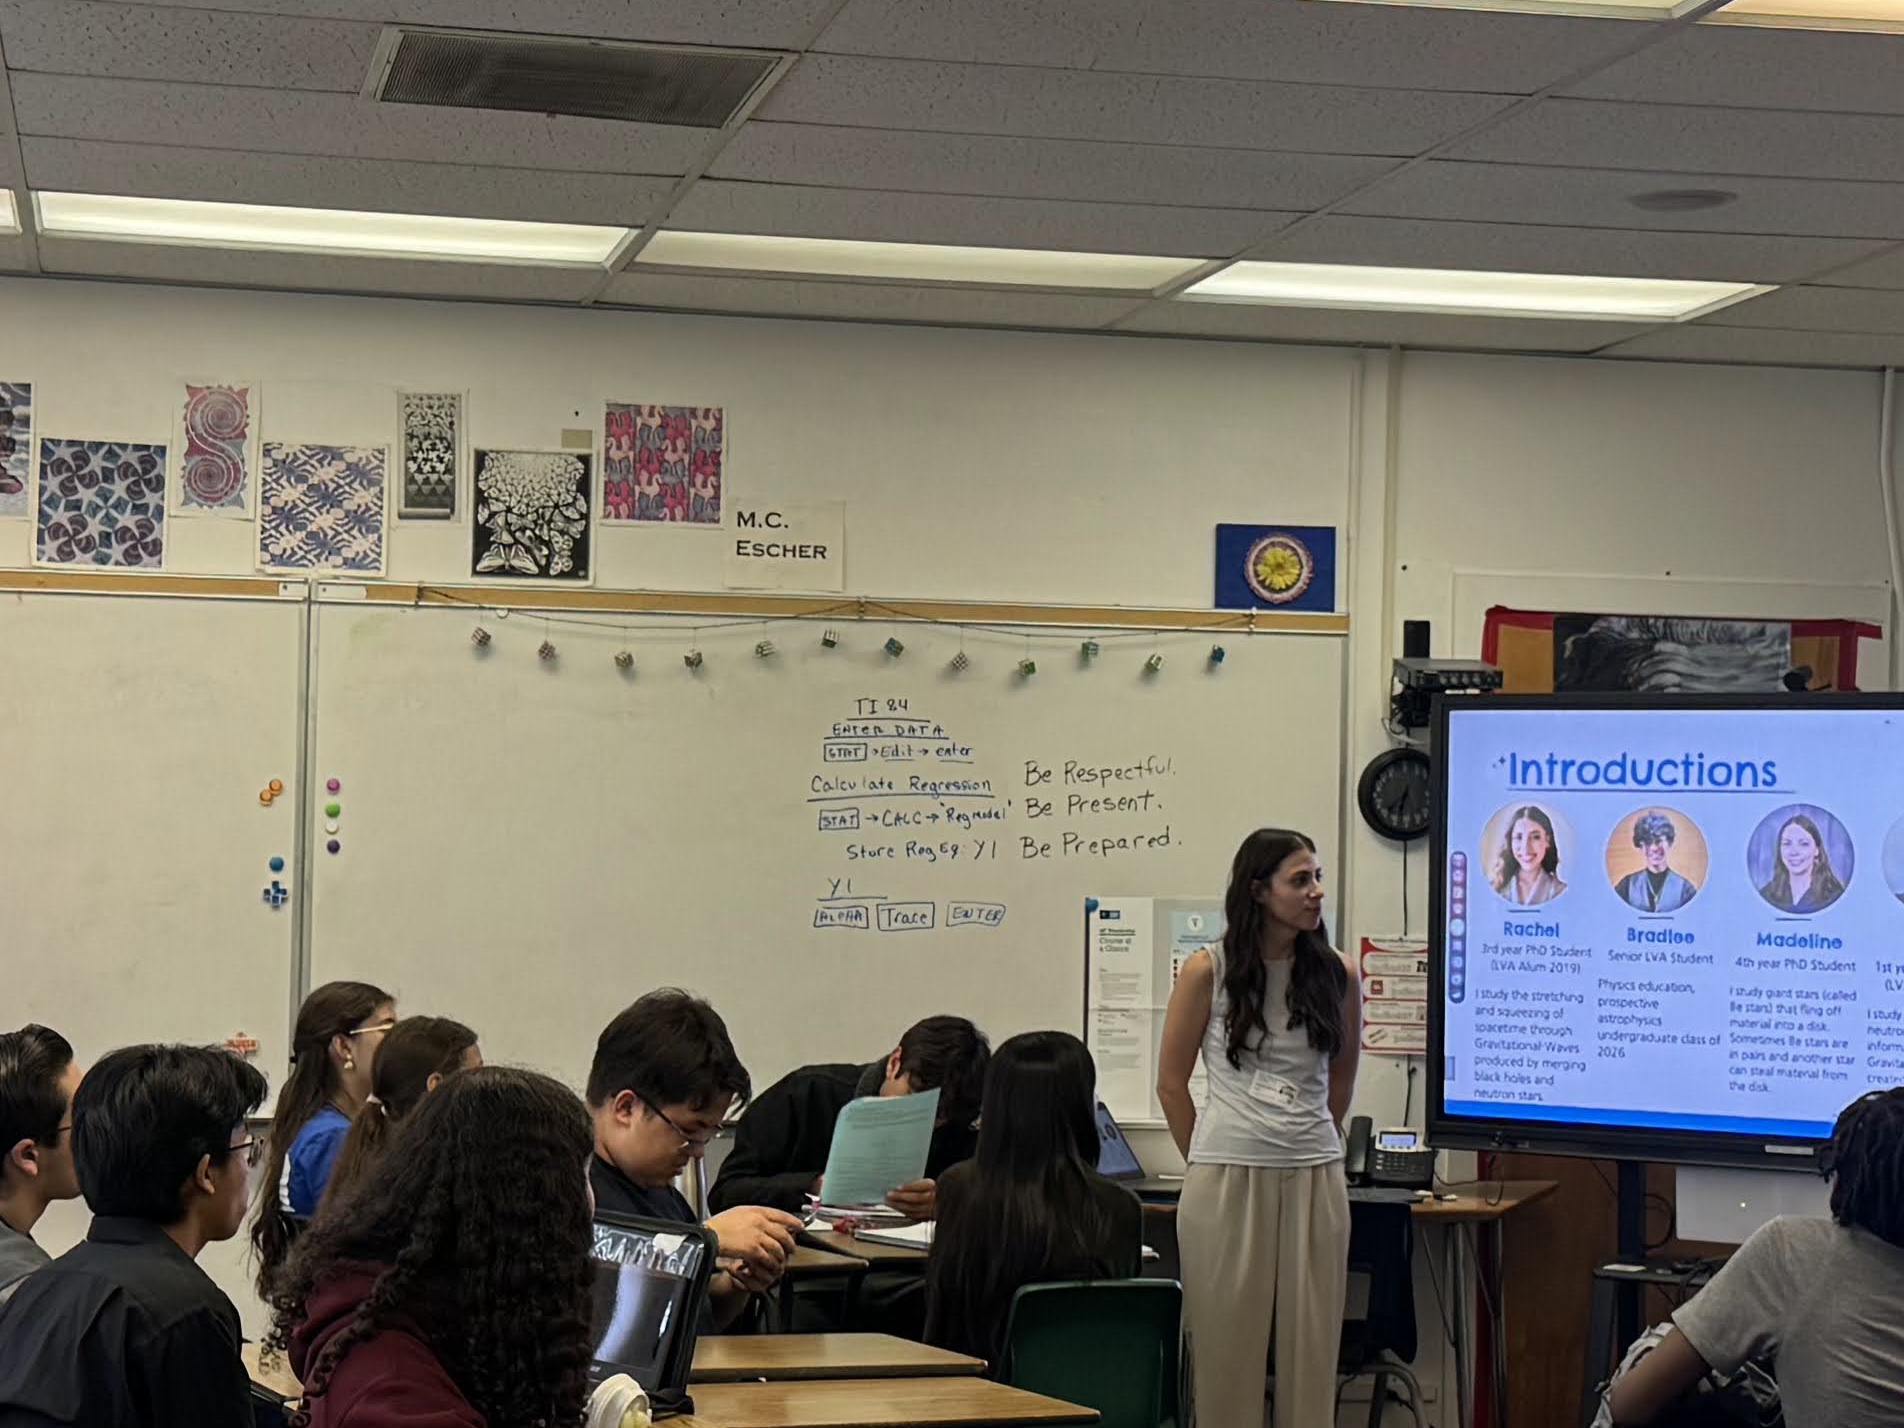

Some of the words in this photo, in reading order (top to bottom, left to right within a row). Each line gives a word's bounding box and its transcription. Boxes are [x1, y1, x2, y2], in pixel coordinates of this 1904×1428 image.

[737, 511, 788, 528] M.C.
[1025, 760, 1052, 786] Be
[1065, 756, 1176, 788] Respectful.
[1509, 752, 1777, 787] Introductions
[811, 776, 894, 792] Calculate
[909, 776, 991, 795] Regression
[1026, 798, 1052, 818] Be
[1067, 790, 1162, 814] Present.
[1020, 836, 1051, 859] Be
[1063, 826, 1183, 859] Prepared.
[1504, 921, 1559, 938] Rachel
[1627, 927, 1695, 944] Bradlee
[1757, 932, 1842, 950] Madeline
[1502, 945, 1522, 958] year
[1526, 945, 1546, 956] PhD
[1551, 945, 1592, 958] Student
[1608, 950, 1642, 962] Senior
[1645, 951, 1666, 963] LVA
[1670, 952, 1713, 965] Student
[1735, 957, 1754, 968] 4th
[1758, 960, 1780, 971] year
[1784, 958, 1807, 970] PhD
[1811, 960, 1856, 972] Student
[1876, 961, 1892, 973] 1st
[1598, 979, 1635, 992] Physics
[1512, 991, 1528, 1001] the
[1532, 991, 1584, 1004] stretching
[1598, 997, 1659, 1011] prospective
[1475, 1006, 1494, 1016] and
[1553, 1008, 1564, 1019] of
[1873, 1010, 1902, 1022] study
[1598, 1030, 1678, 1045] undergraduate
[1709, 1035, 1721, 1045] of
[1598, 1047, 1625, 1059] 2026
[1527, 1058, 1539, 1070] by
[1543, 1060, 1586, 1072] merging
[1534, 1075, 1554, 1086] and
